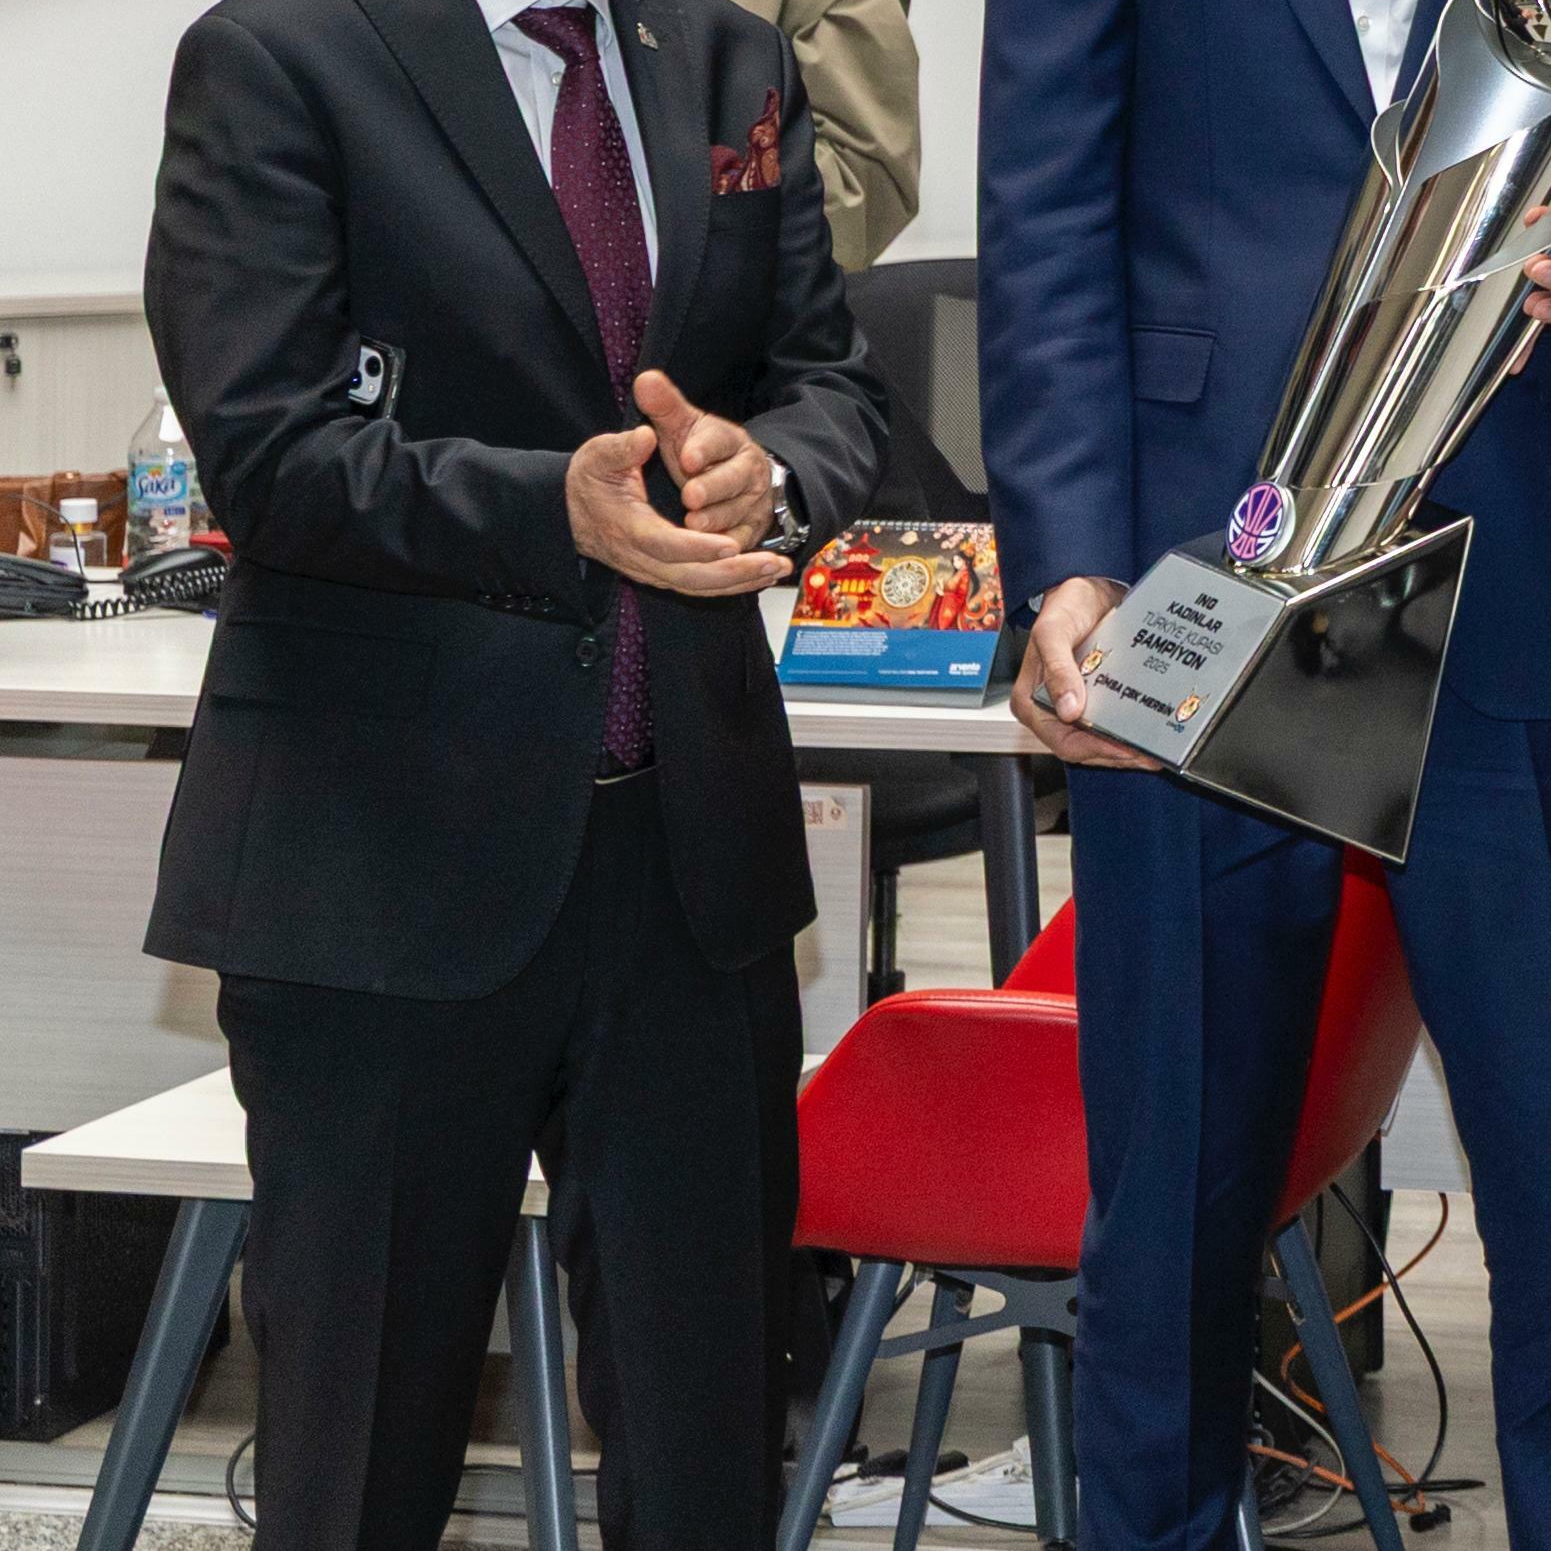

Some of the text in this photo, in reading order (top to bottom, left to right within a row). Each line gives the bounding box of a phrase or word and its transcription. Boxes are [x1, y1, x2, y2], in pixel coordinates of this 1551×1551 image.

[1166, 600, 1223, 634] KADINLAR
[1130, 628, 1208, 671] ŞAMPİYON
[1142, 655, 1171, 675] 2025
